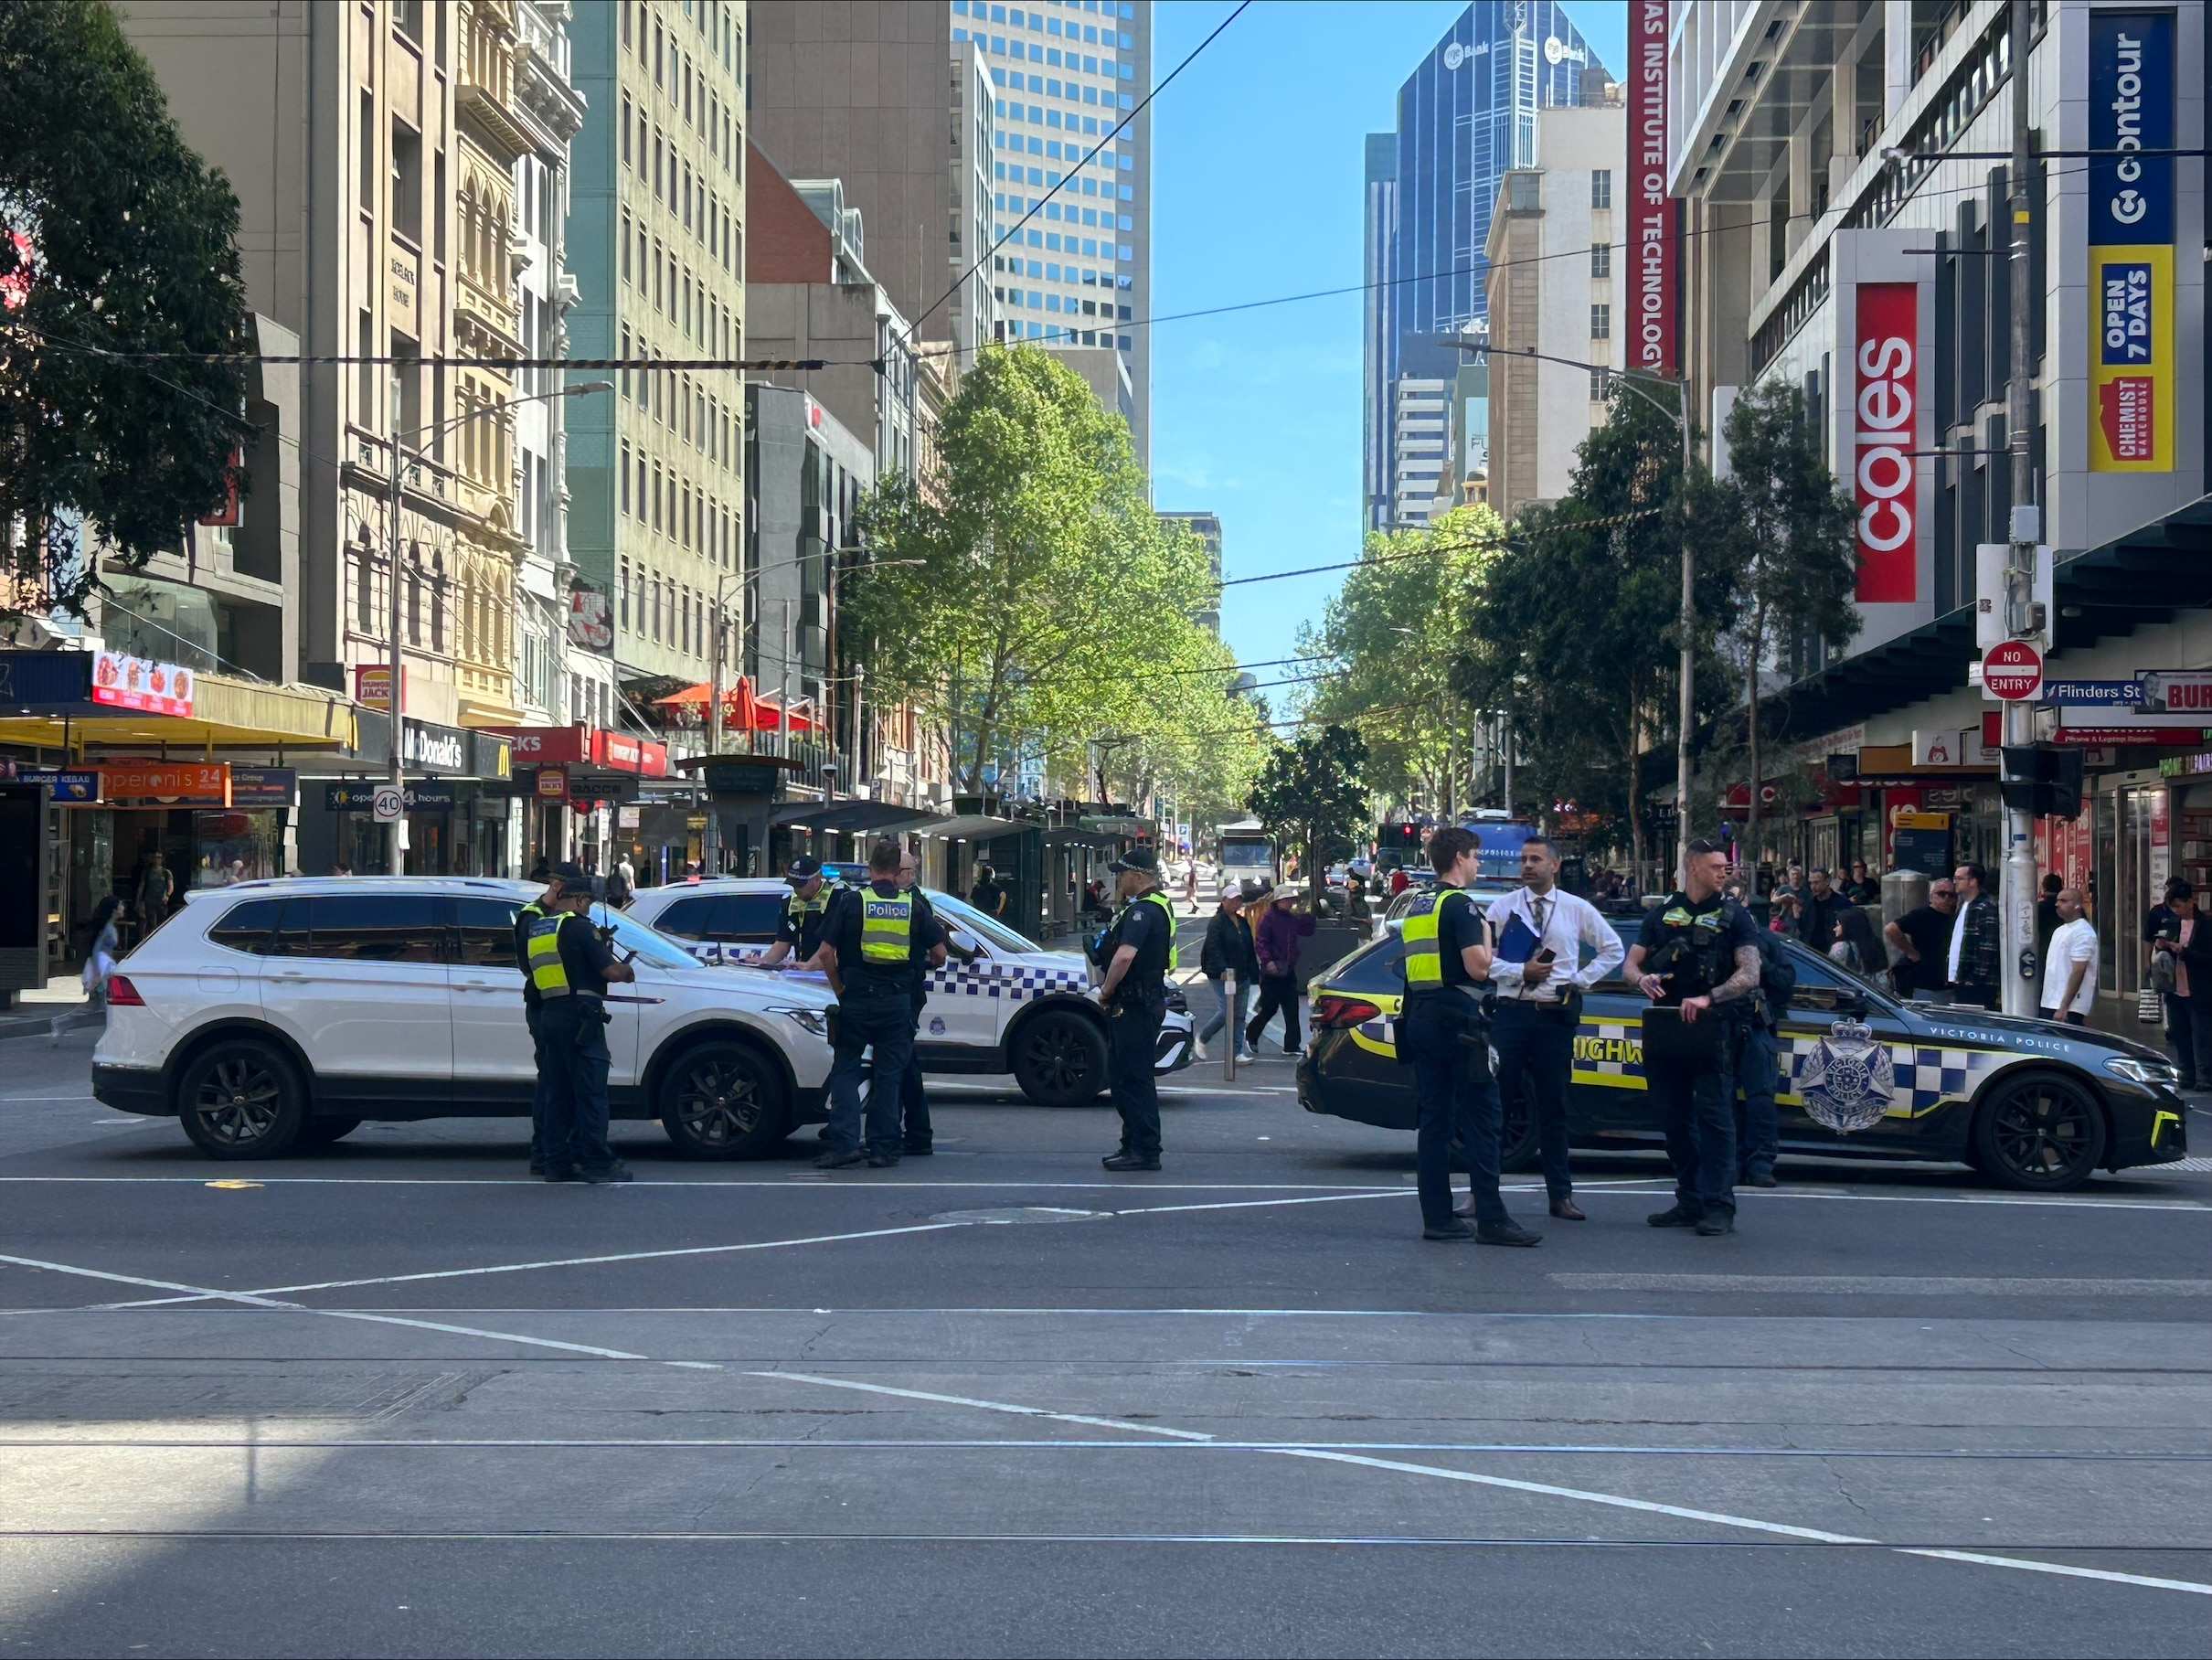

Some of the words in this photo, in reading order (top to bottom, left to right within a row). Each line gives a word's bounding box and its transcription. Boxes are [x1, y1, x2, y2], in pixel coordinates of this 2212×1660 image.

[1643, 1, 1664, 35] AS
[1643, 43, 1664, 165] INSTITUTE
[2111, 33, 2142, 182] contour
[1643, 172, 1663, 206] OF
[2107, 280, 2126, 348] OPEN
[2128, 270, 2147, 336] DAYS
[2128, 344, 2147, 358] 7
[2119, 380, 2136, 457] CHEMIST
[1856, 337, 1912, 551] coles
[2003, 651, 2021, 663] NO
[363, 688, 389, 697] JACK
[1991, 679, 2032, 690] ENTRY
[2058, 685, 2119, 698] Flinders
[2123, 685, 2141, 698] St
[404, 728, 462, 768] McDonald's
[199, 769, 219, 783] 24
[378, 796, 399, 811] 40
[403, 790, 416, 806] 4
[418, 793, 451, 803] hours
[1930, 1027, 2005, 1044] VICTORIA
[2015, 1037, 2069, 1053] POLICE
[1827, 1058, 1870, 1080] VICTORIA
[1829, 1084, 1866, 1099] POLICE
